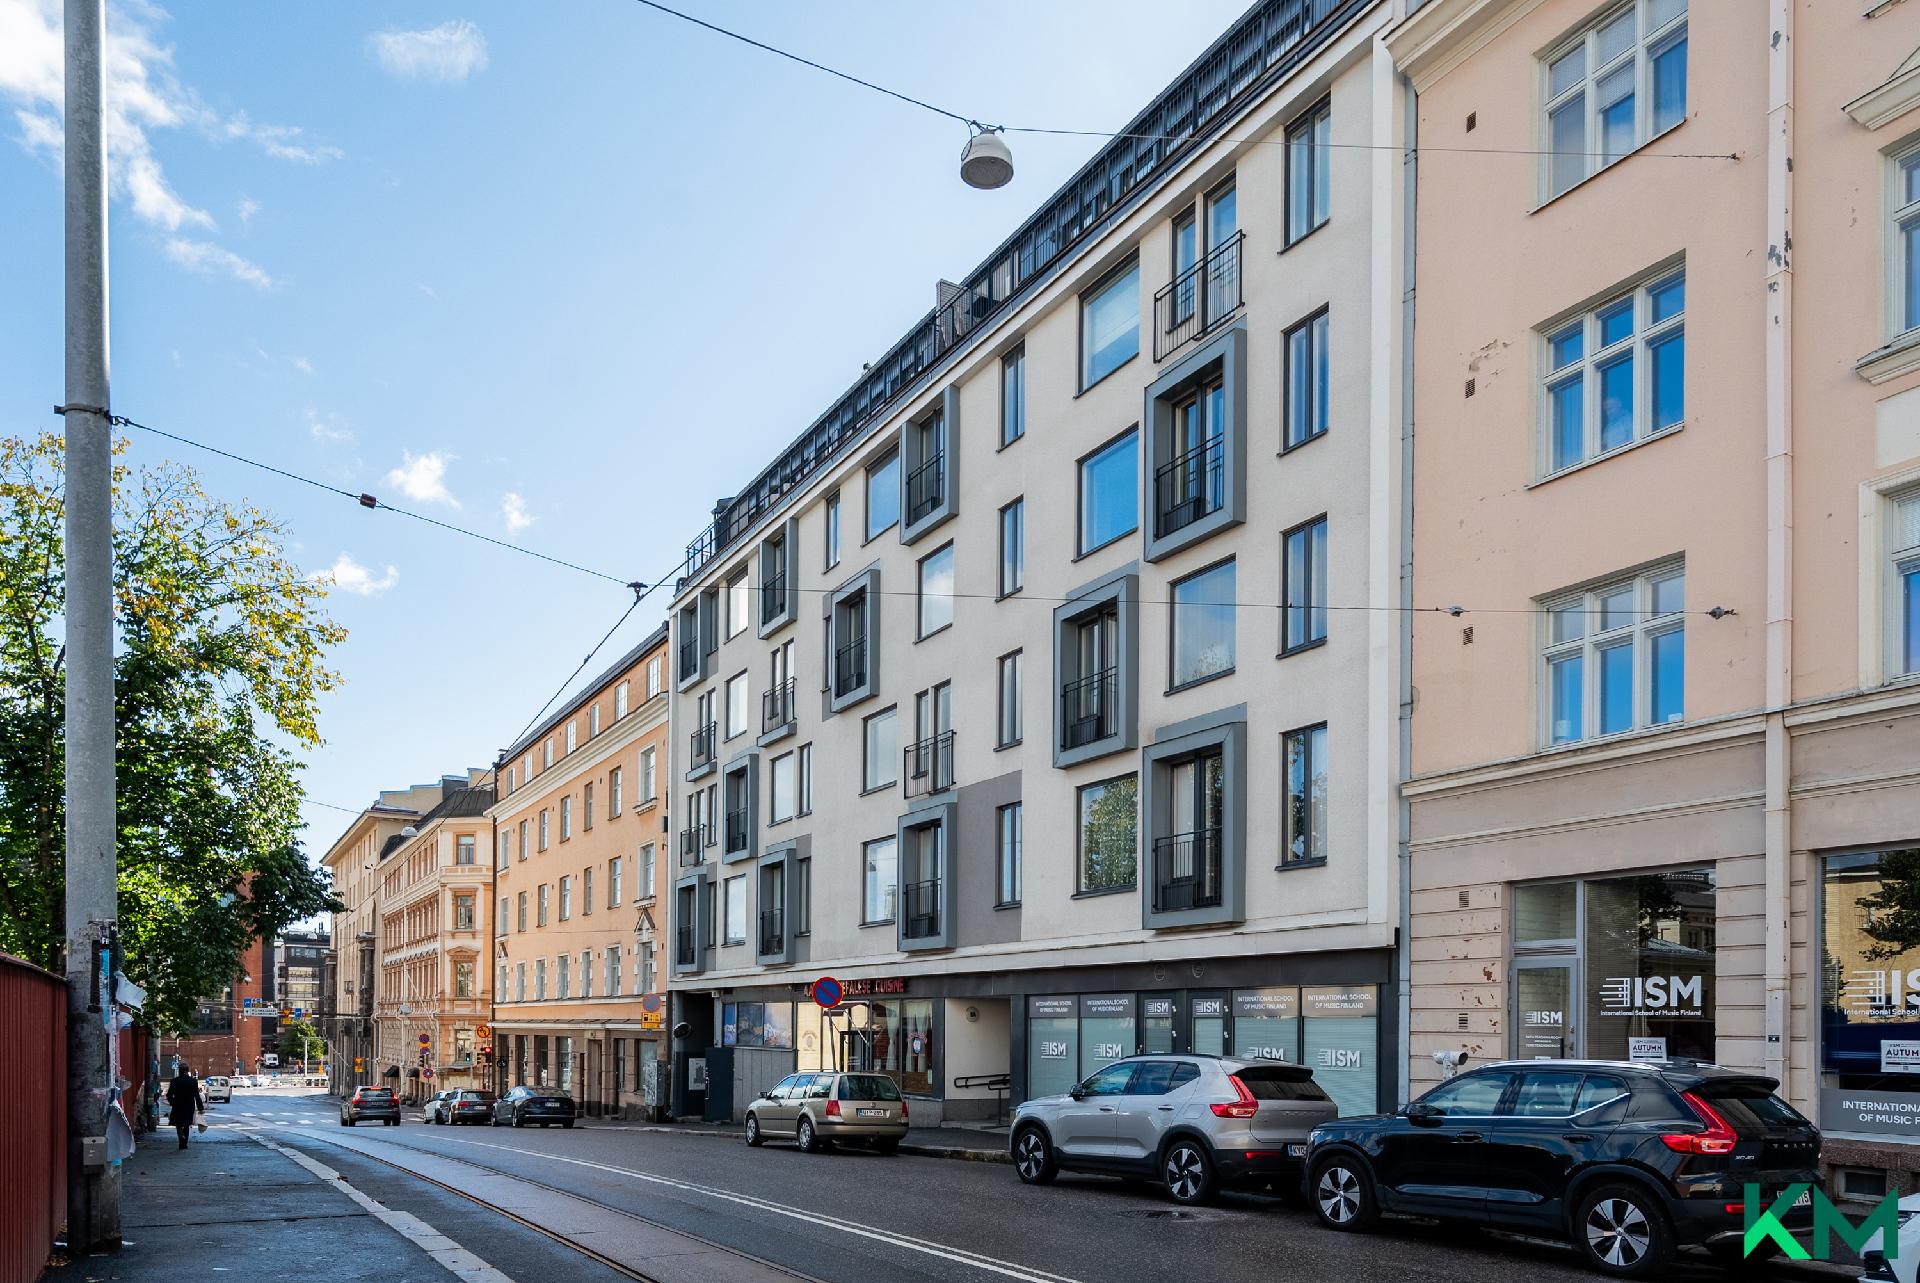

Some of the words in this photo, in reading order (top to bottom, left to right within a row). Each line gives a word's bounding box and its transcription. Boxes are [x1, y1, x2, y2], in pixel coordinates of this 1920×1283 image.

[1634, 975, 1702, 1008] ISM
[1203, 1001, 1220, 1013] ISM
[1537, 1011, 1563, 1024] ISM
[1102, 1043, 1122, 1057] ISM
[1258, 1047, 1284, 1060] ISM
[1331, 1050, 1361, 1068] ISM
[1858, 1113, 1874, 1122] OF
[1875, 1114, 1912, 1125] MUSIC
